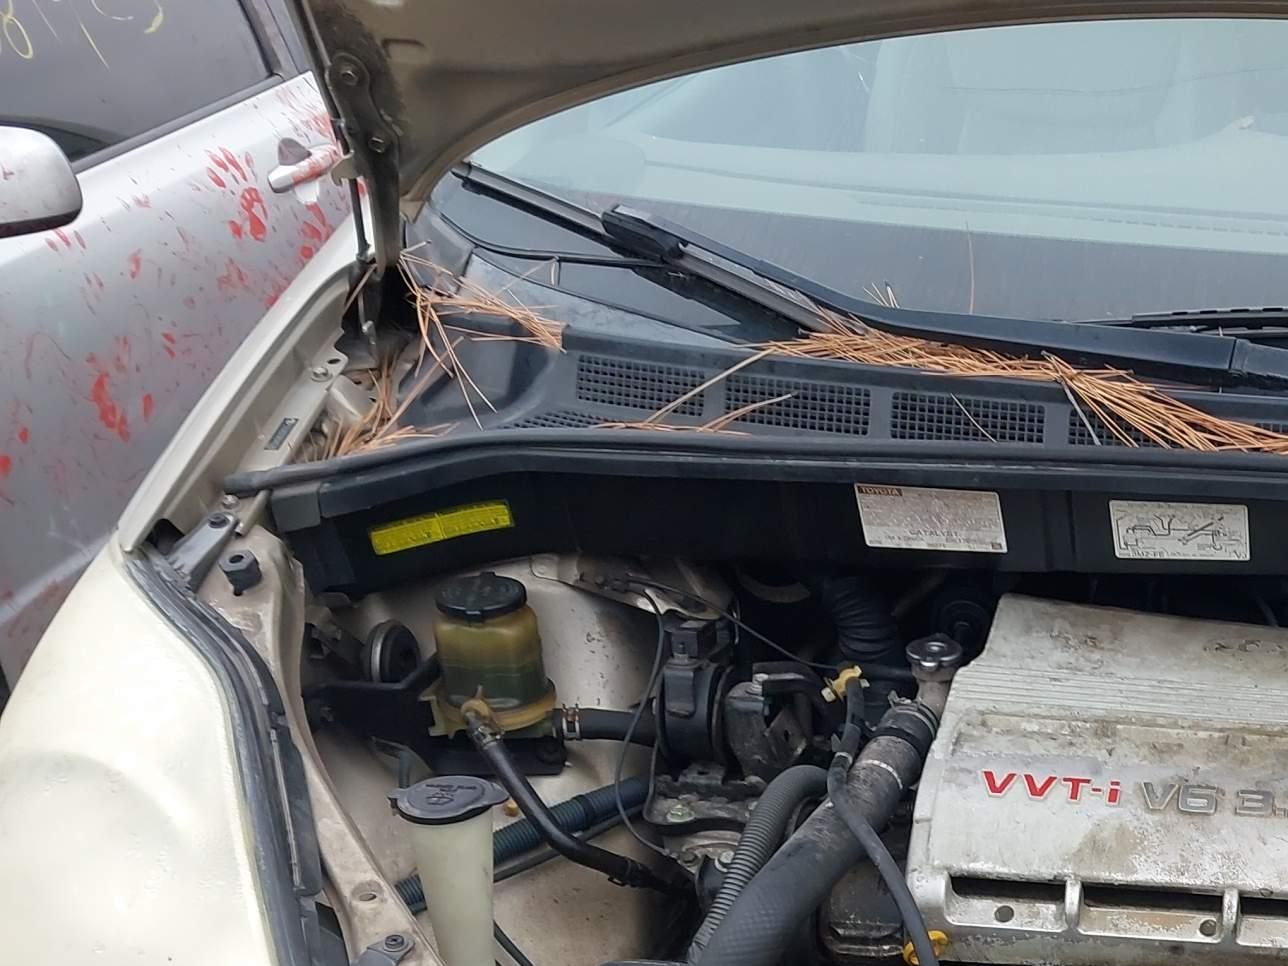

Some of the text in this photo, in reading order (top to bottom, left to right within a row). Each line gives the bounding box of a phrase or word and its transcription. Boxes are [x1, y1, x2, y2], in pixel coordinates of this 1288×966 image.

[861, 486, 900, 496] TOYOTA
[982, 769, 1122, 806] VVT-i
[1141, 781, 1220, 816] V6
